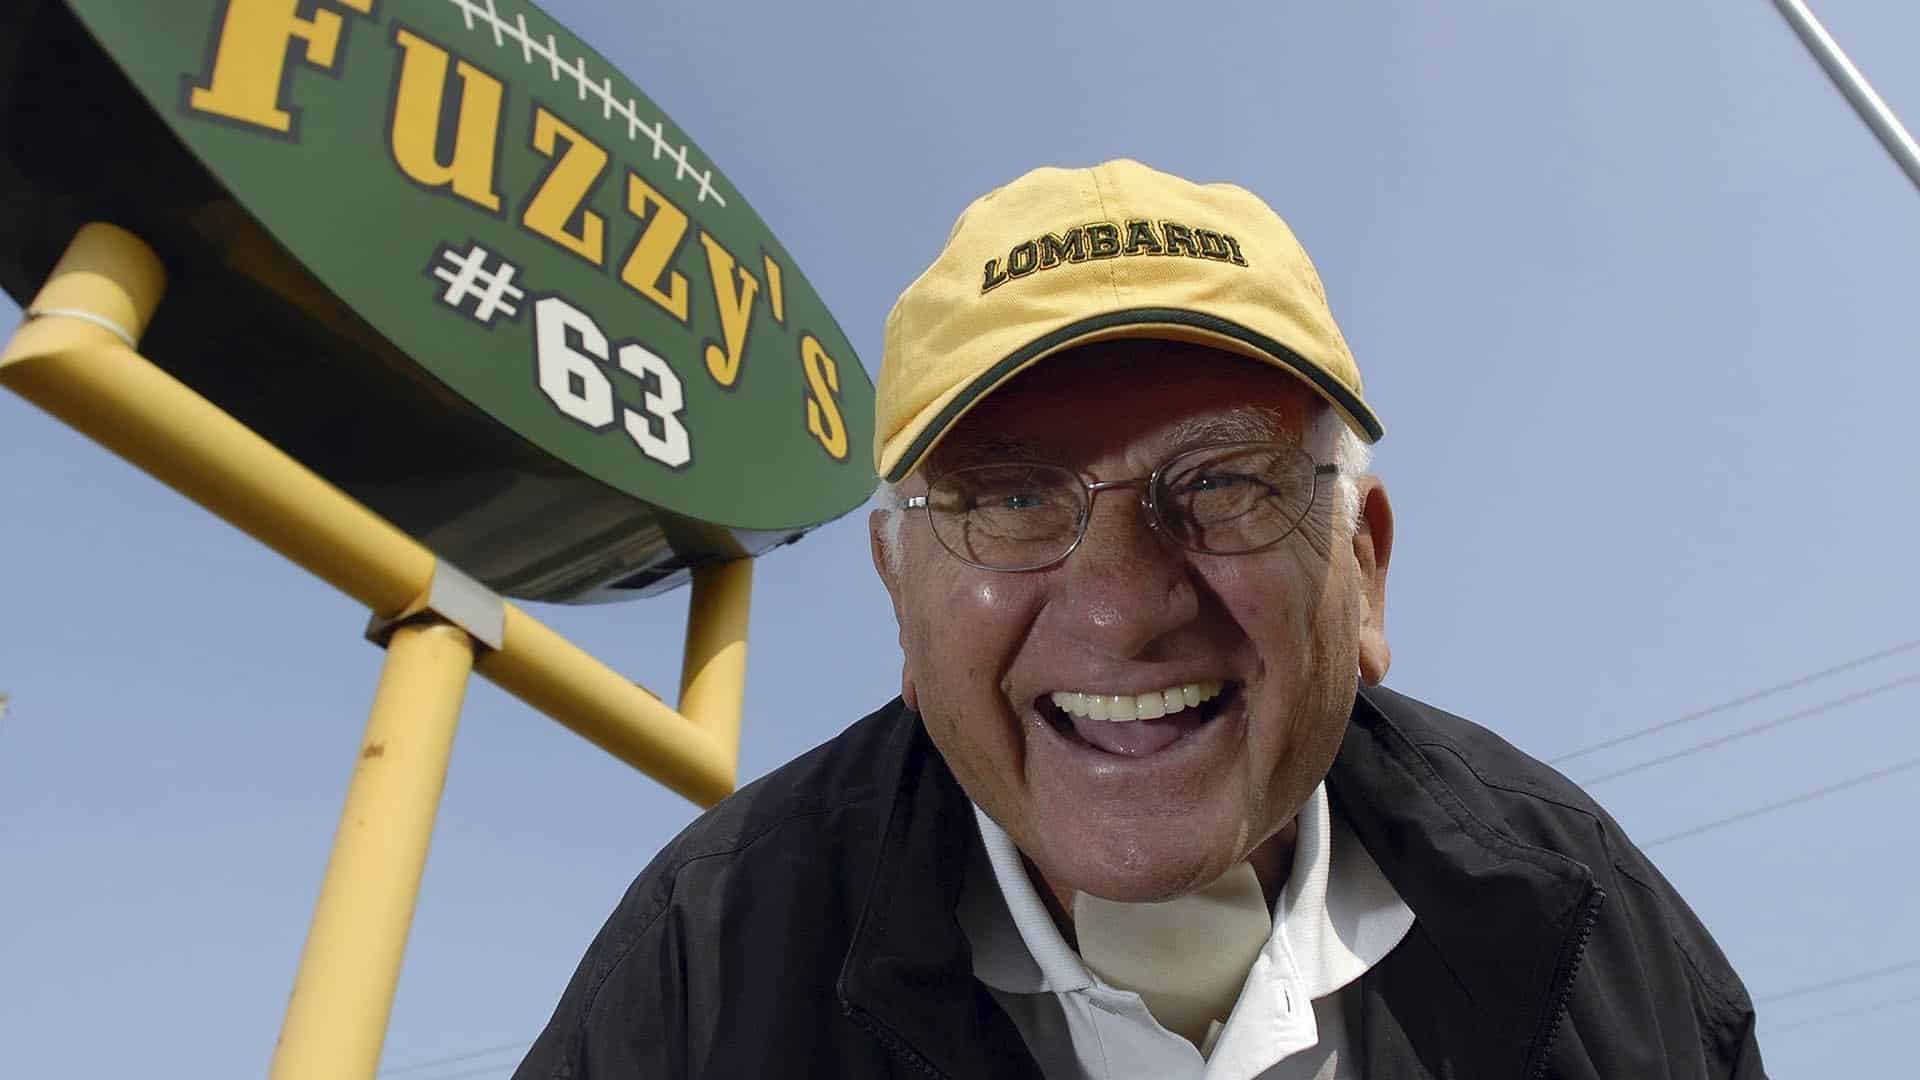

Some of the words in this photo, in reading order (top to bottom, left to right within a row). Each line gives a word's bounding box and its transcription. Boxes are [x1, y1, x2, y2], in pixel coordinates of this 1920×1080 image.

[187, 0, 850, 461] Fuzzy's
[981, 219, 1249, 294] LOMBARDI
[432, 245, 692, 468] #63
